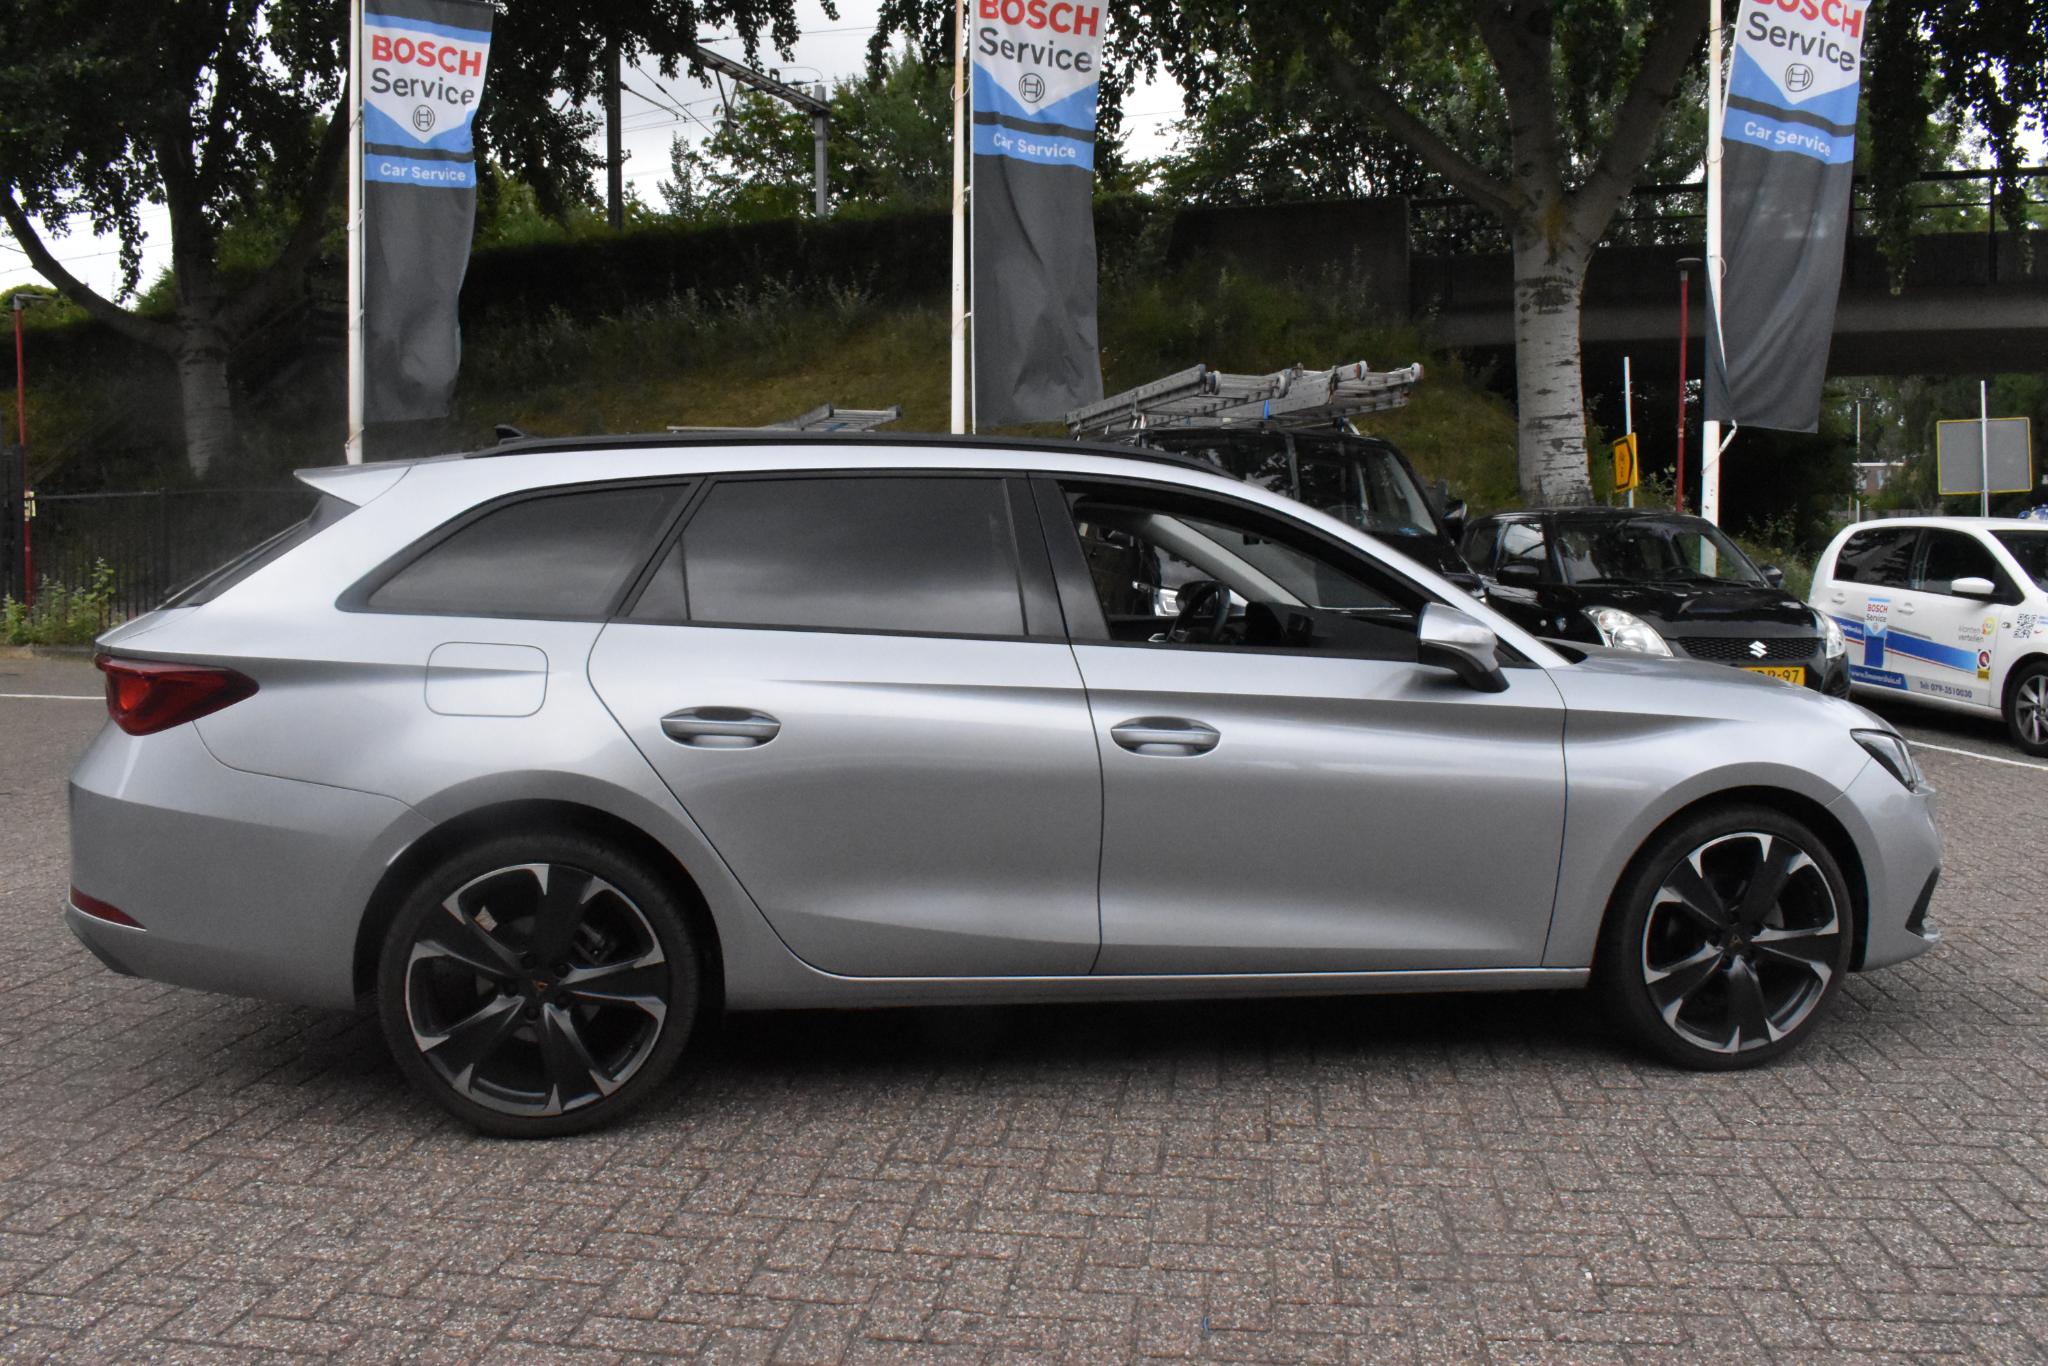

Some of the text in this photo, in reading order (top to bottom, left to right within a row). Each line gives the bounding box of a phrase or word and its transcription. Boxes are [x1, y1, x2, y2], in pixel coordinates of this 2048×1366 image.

[979, 0, 1100, 37] BOSCH
[1755, 0, 1864, 38] SCH
[371, 34, 482, 77] BOSCH
[978, 27, 1093, 73] Service
[1746, 11, 1856, 71] Service
[370, 67, 475, 105] Service
[993, 132, 1076, 158] Car Service
[1744, 121, 1832, 157] Car Service
[380, 162, 467, 182] Car Service
[1866, 603, 1888, 613] BOSCH
[1866, 613, 1887, 622] Service
